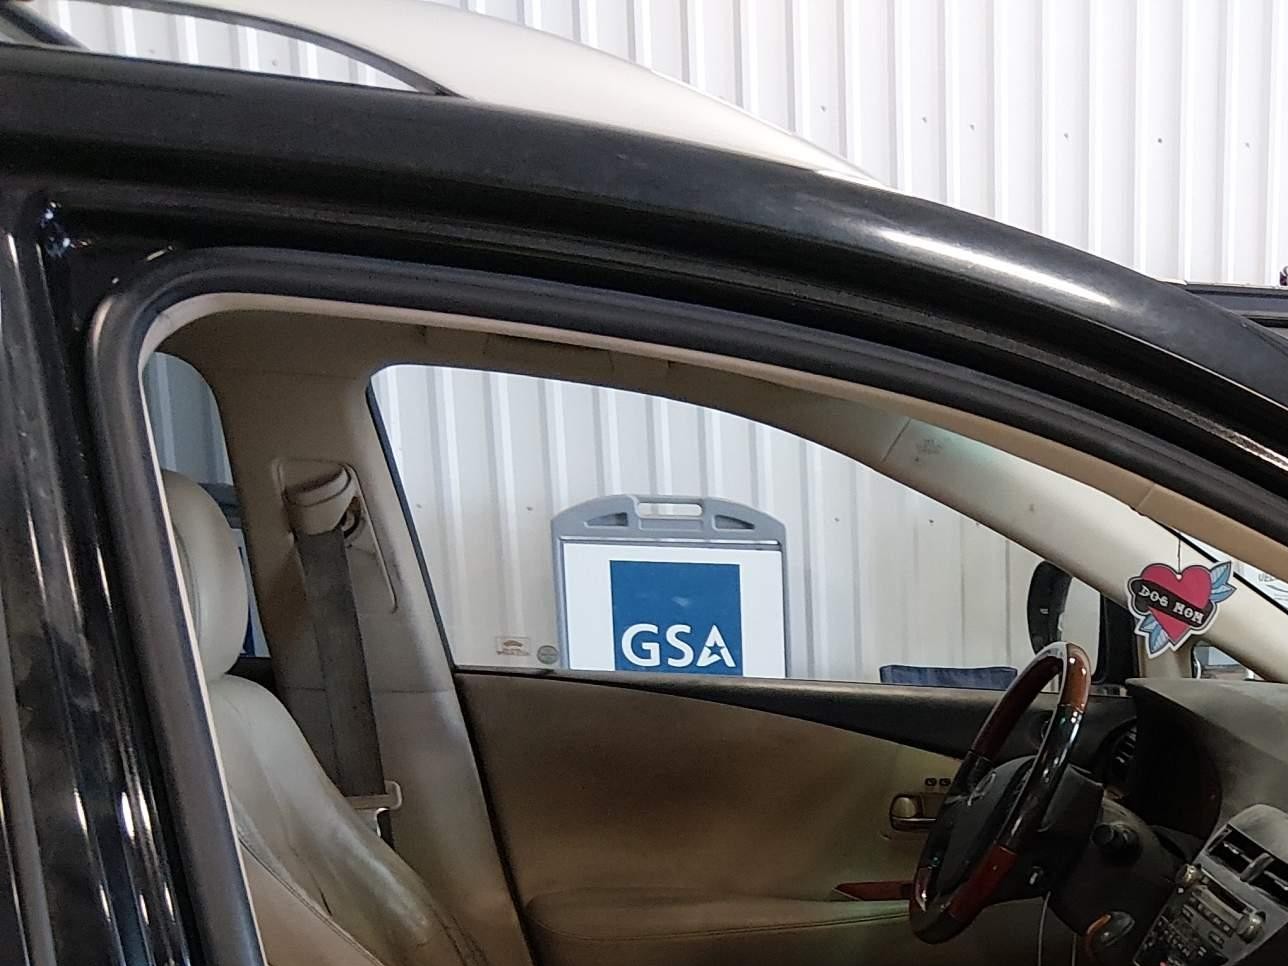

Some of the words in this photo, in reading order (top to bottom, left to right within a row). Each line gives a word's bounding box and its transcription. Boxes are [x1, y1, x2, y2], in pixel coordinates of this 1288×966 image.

[1138, 583, 1169, 608] DOG
[1172, 602, 1205, 625] MOM
[621, 623, 737, 668] GSA
